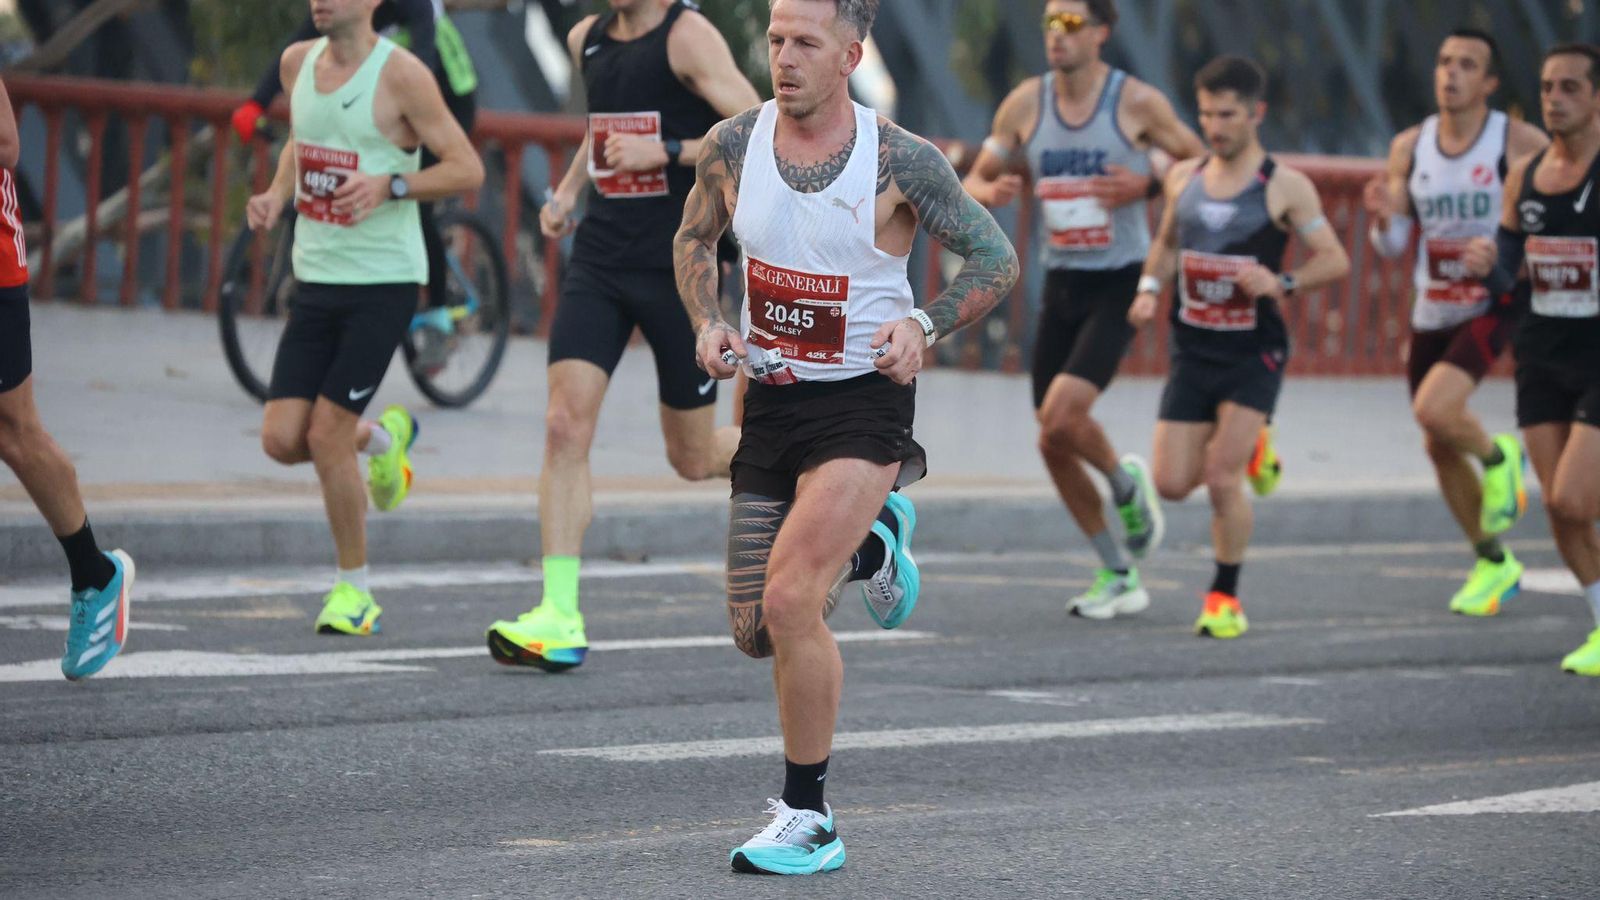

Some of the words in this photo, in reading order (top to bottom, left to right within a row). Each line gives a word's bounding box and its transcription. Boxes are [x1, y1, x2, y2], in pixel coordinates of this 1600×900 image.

[766, 269, 840, 294] GENERALI
[764, 301, 815, 329] 2045
[773, 324, 802, 336] HALSEY
[806, 351, 827, 360] 42K
